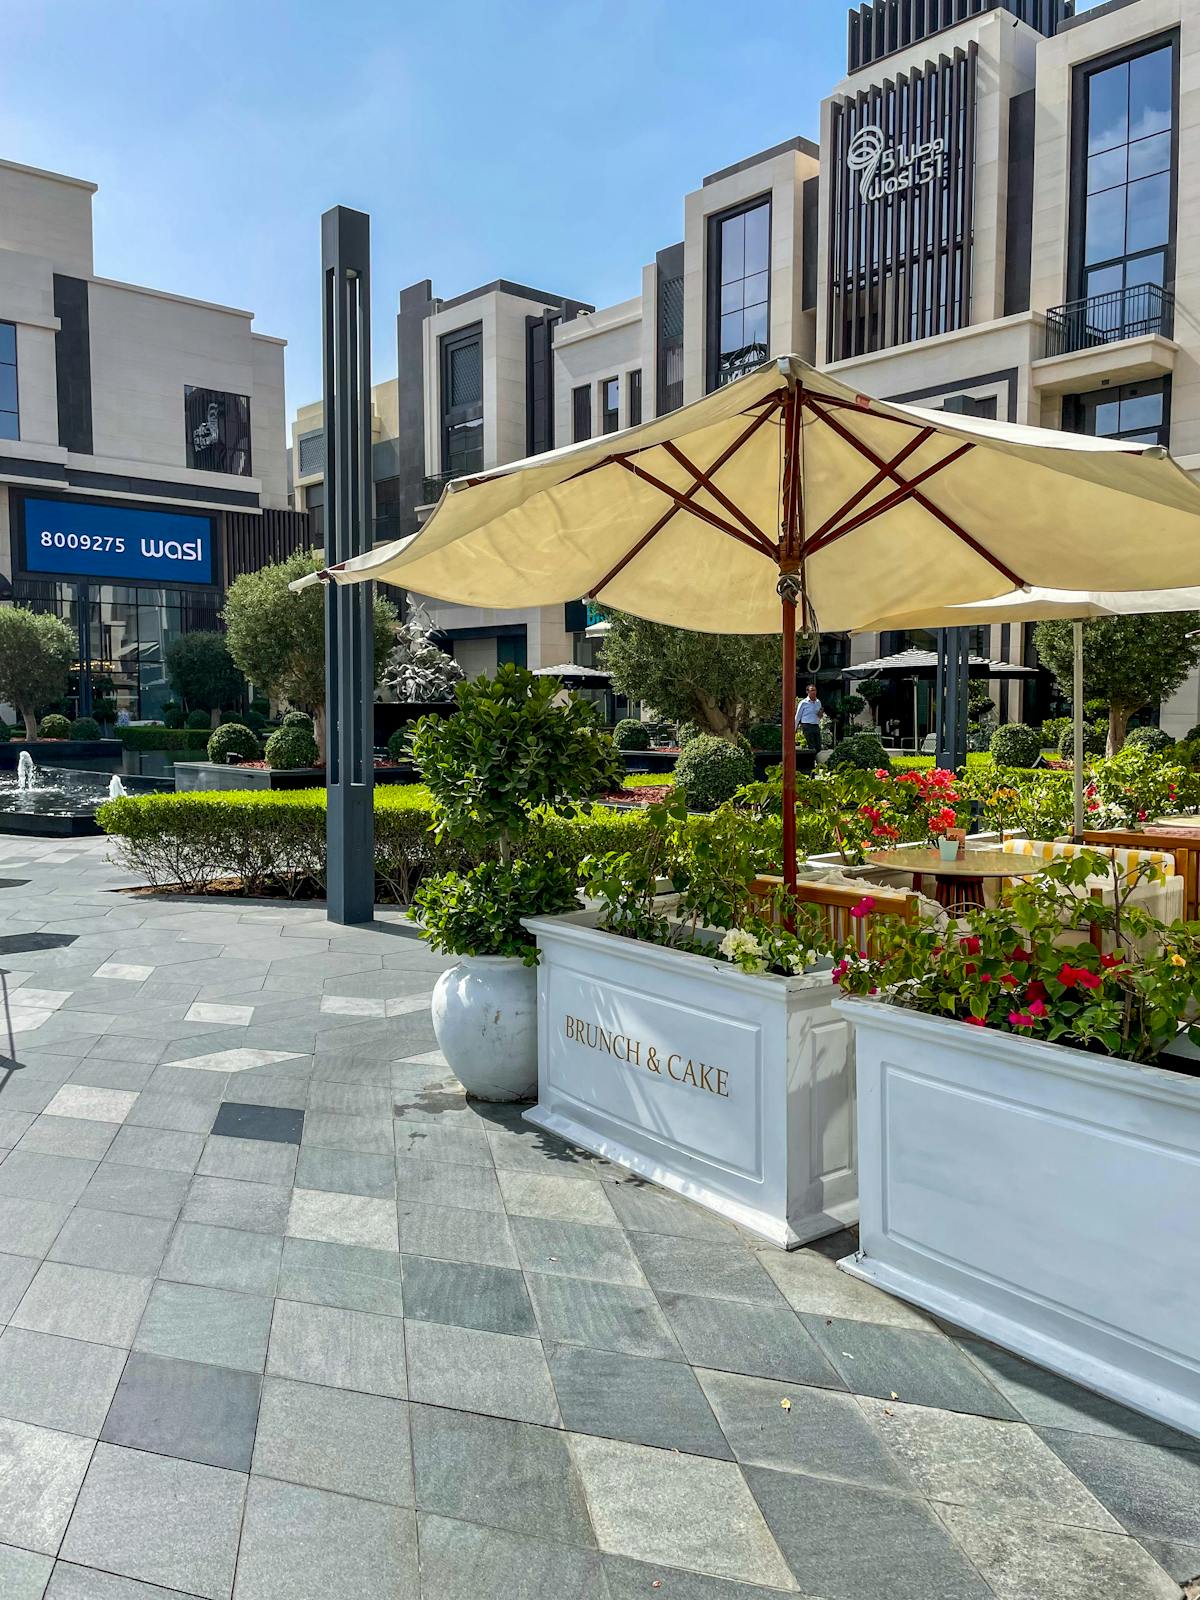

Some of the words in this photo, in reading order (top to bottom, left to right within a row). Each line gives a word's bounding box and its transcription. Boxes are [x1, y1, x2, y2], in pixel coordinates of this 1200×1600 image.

[868, 166, 913, 200] wasl
[919, 153, 942, 184] 51
[41, 531, 125, 553] 8009275
[141, 538, 202, 561] wasl
[565, 1015, 641, 1066] BRUNCH
[646, 1047, 662, 1075] &
[667, 1054, 729, 1098] CAKE
